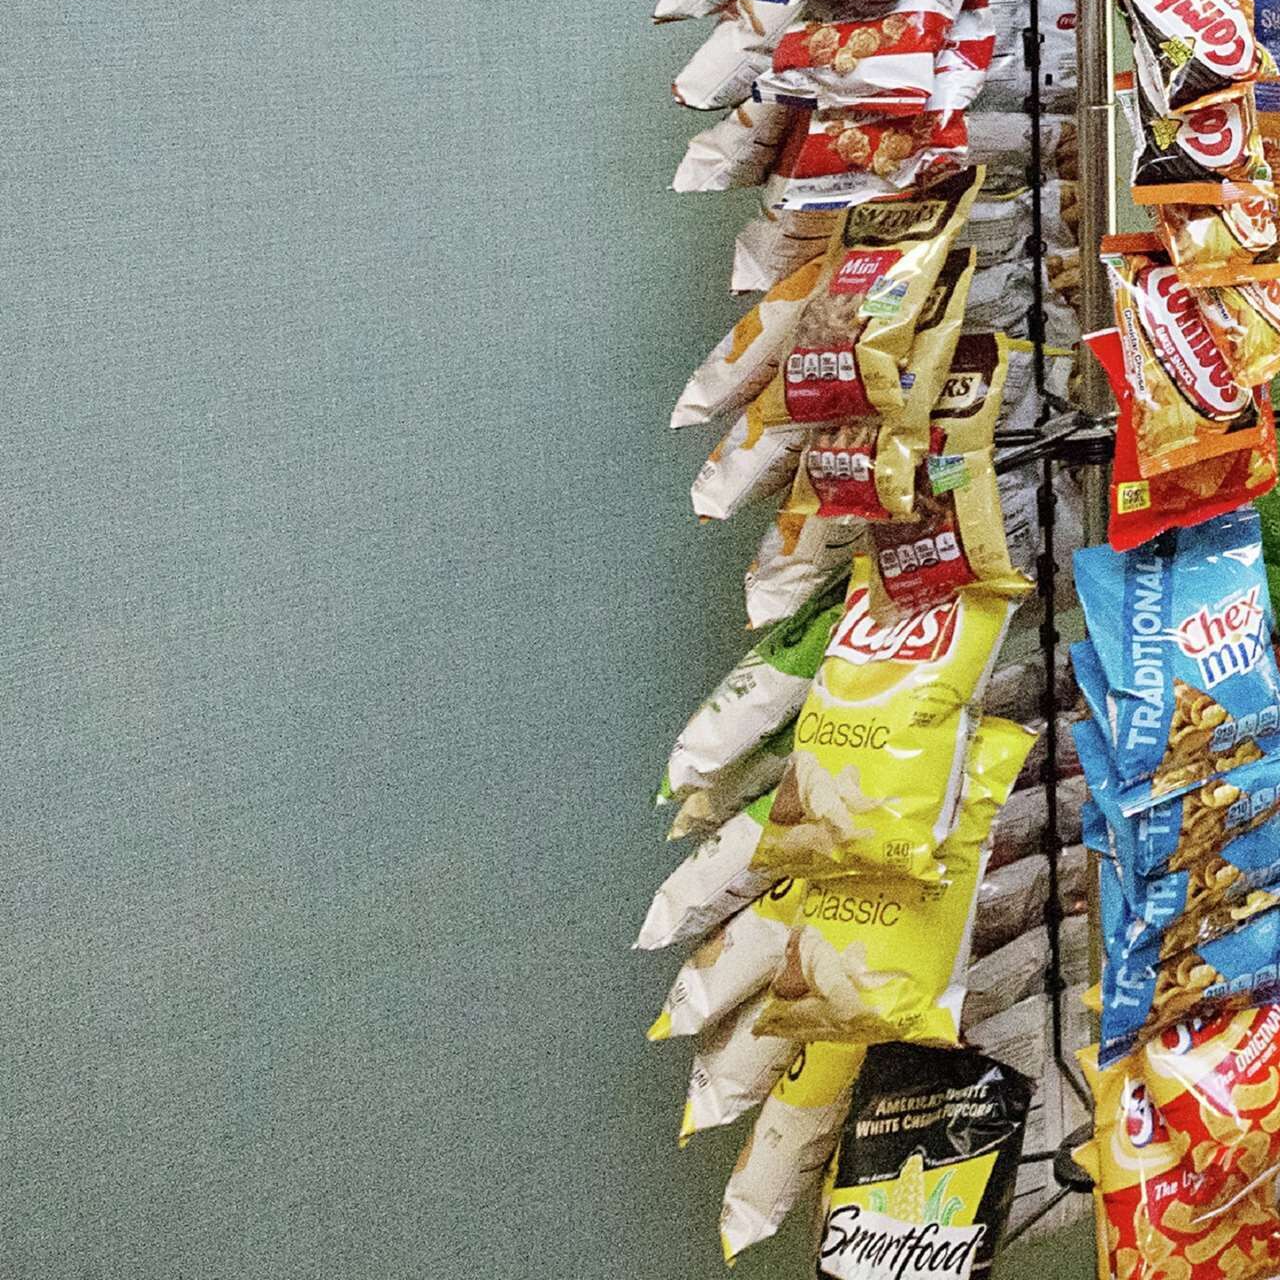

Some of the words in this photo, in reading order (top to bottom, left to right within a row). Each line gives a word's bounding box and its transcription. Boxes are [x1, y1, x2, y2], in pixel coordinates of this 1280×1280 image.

[840, 257, 883, 276] Mini
[1181, 589, 1262, 655] Chex
[1126, 556, 1164, 750] TRADITIONAL
[1201, 619, 1265, 684] mix
[798, 711, 890, 750] Classic
[802, 885, 902, 927] Classic
[856, 1118, 900, 1140] WHITE
[1154, 1181, 1179, 1199] The
[821, 1204, 986, 1280] Smartfood
